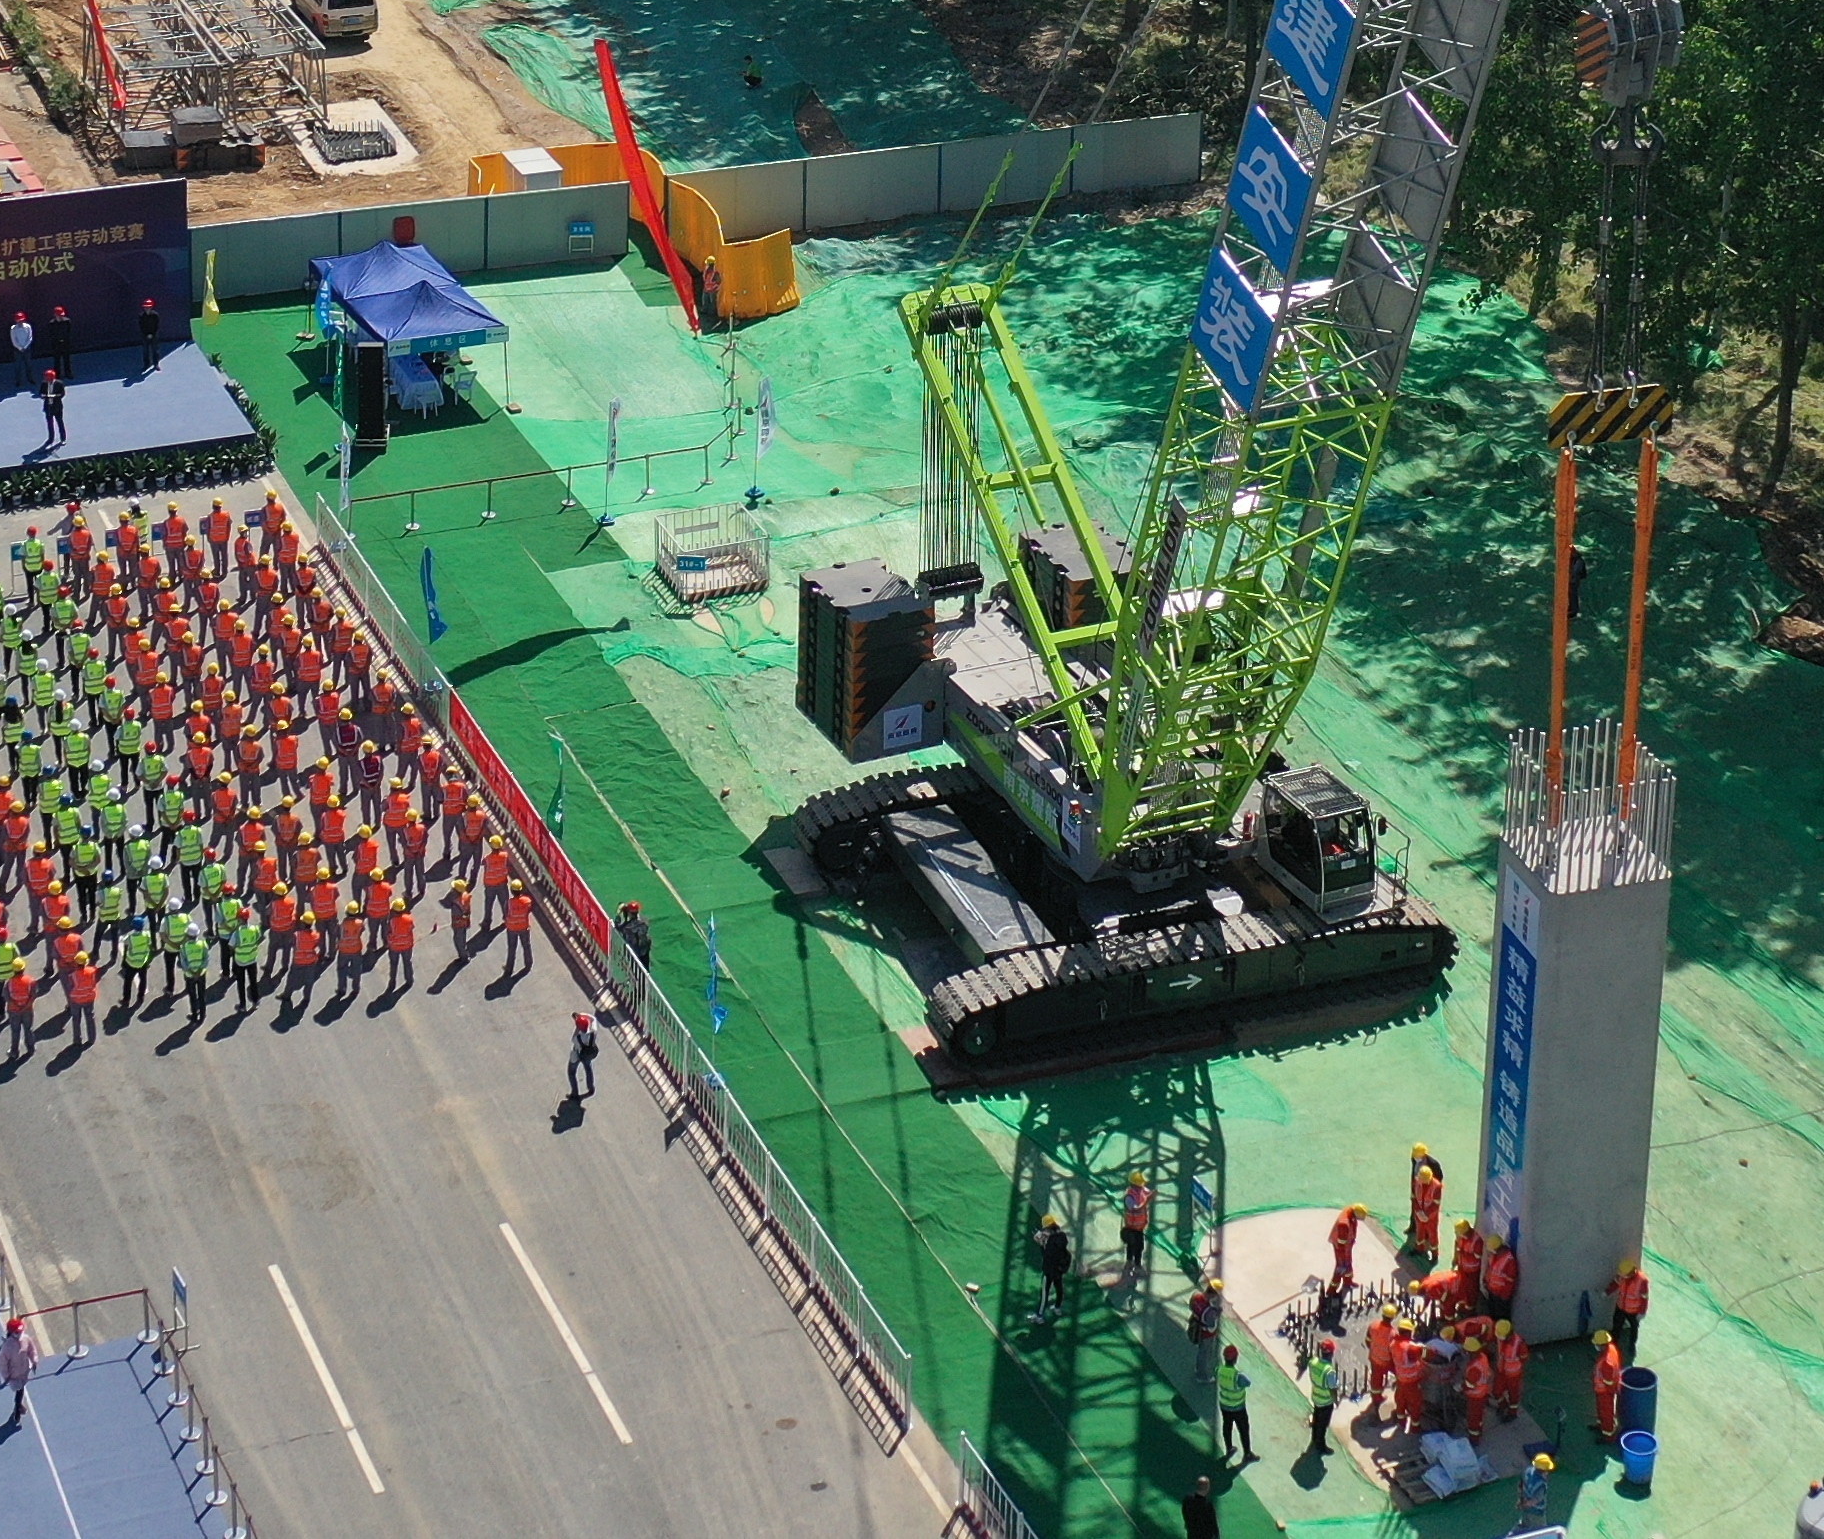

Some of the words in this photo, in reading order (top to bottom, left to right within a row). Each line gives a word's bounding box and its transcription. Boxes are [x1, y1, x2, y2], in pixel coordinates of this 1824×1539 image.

[429, 335, 467, 348] 休息区
[1139, 510, 1183, 651] ZOOMLION
[1502, 945, 1530, 1070] 精益求精
